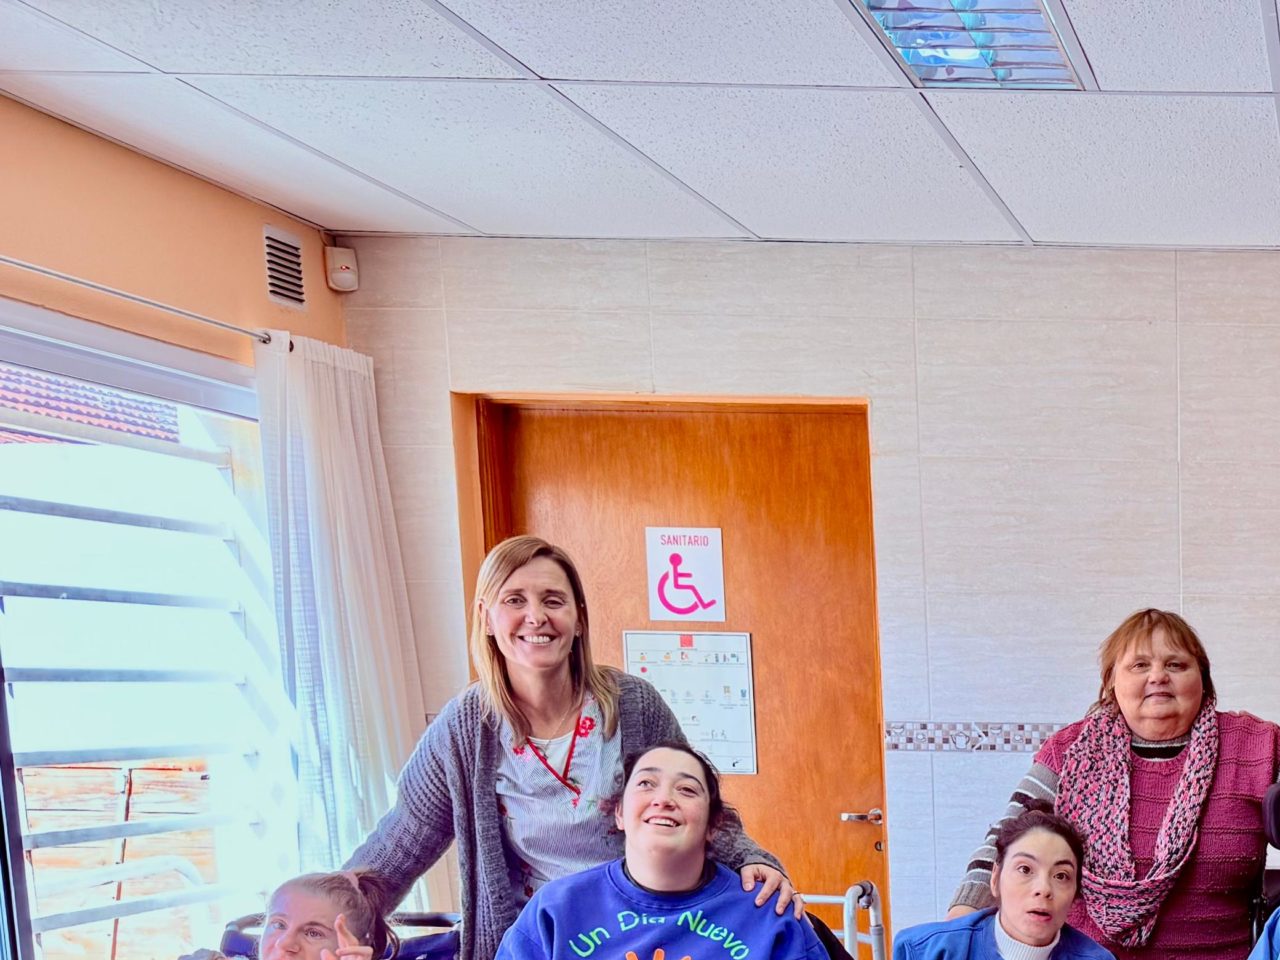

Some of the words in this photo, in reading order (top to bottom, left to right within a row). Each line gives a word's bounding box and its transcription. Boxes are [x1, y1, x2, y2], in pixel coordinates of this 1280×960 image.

[660, 534, 709, 547] SANITARIO
[568, 926, 611, 958] Un
[676, 910, 750, 960] Nuevo
